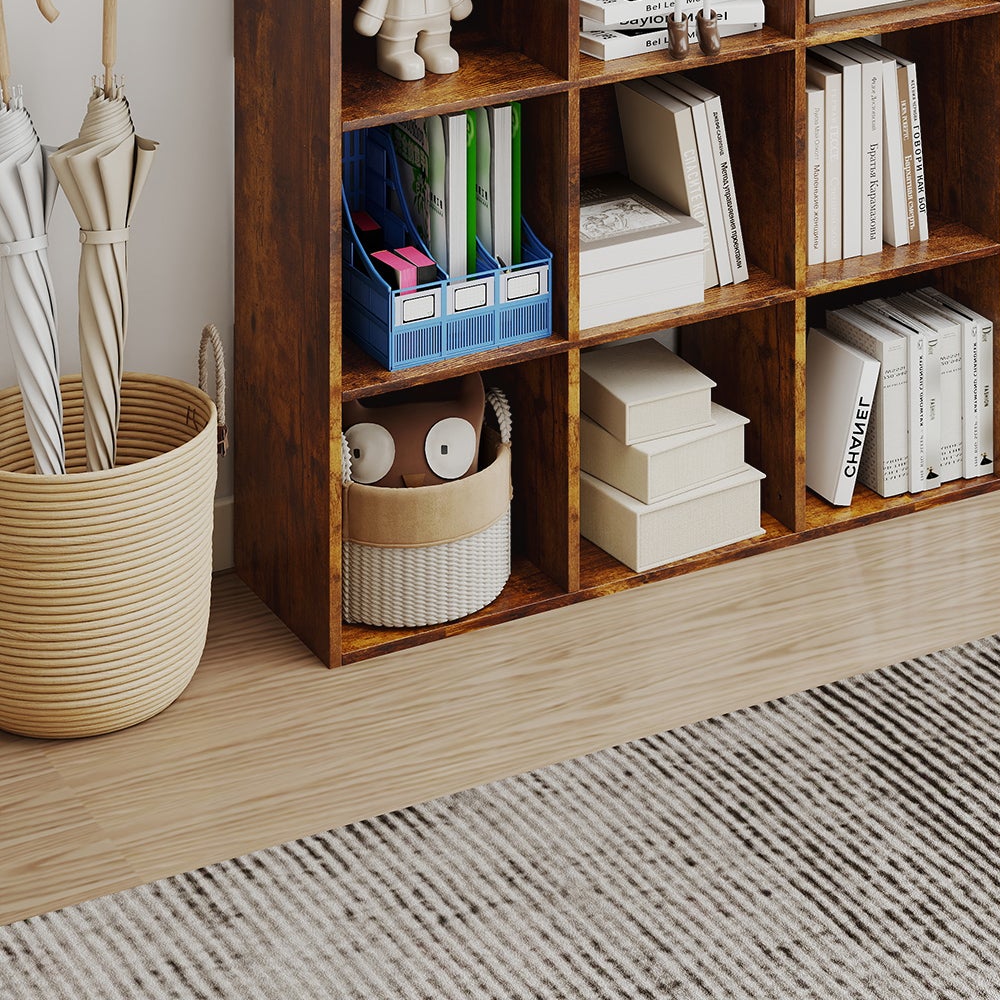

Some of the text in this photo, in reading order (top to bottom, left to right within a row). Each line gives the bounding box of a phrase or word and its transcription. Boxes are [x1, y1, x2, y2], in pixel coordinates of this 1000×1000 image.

[645, 3, 661, 12] Bel
[645, 37, 661, 47] Bel
[913, 125, 924, 173] ГОВОРИ
[867, 143, 879, 241] Братья Карамазовы
